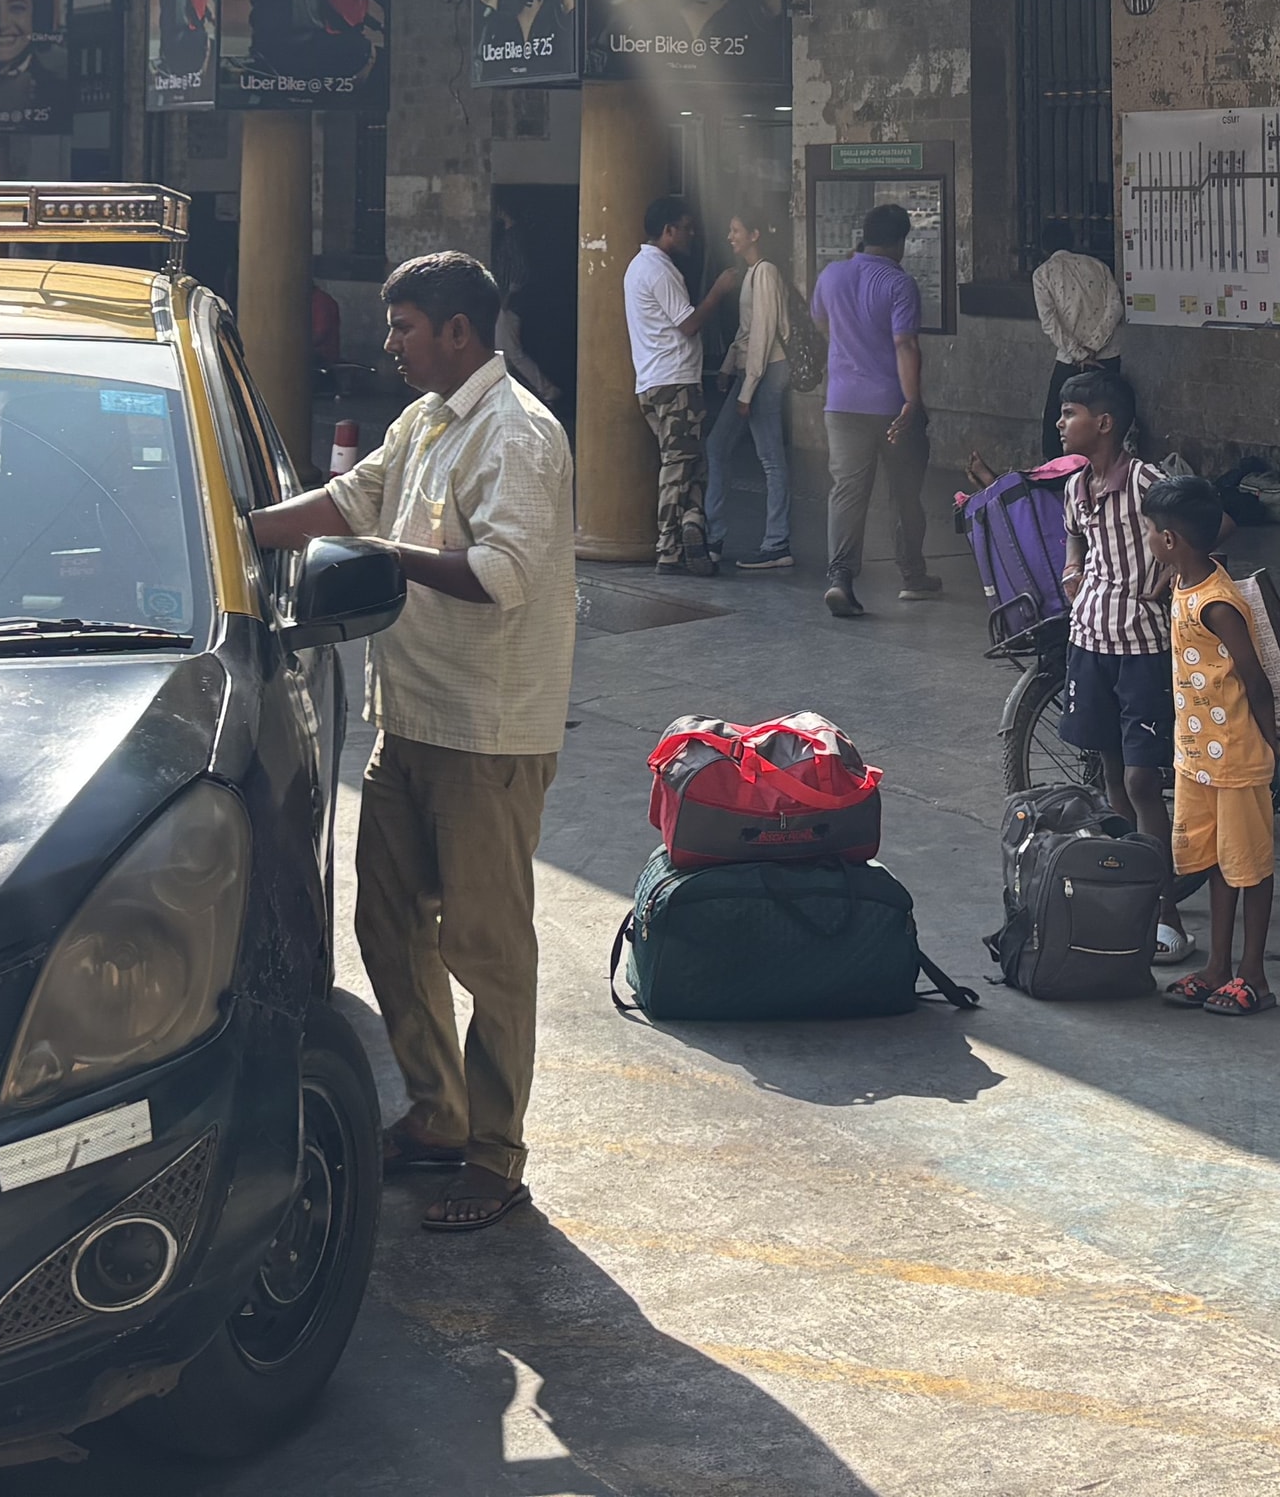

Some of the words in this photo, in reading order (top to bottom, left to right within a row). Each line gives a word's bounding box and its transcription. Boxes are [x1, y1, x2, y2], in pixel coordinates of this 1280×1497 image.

[483, 44, 505, 62] Uber
[505, 41, 522, 60] Bike
[523, 42, 532, 60] @
[610, 34, 652, 53] Uber
[655, 36, 688, 54] Bike
[691, 39, 707, 57] @
[240, 75, 274, 90] Uber
[278, 76, 307, 91] Bike
[308, 79, 321, 93] @
